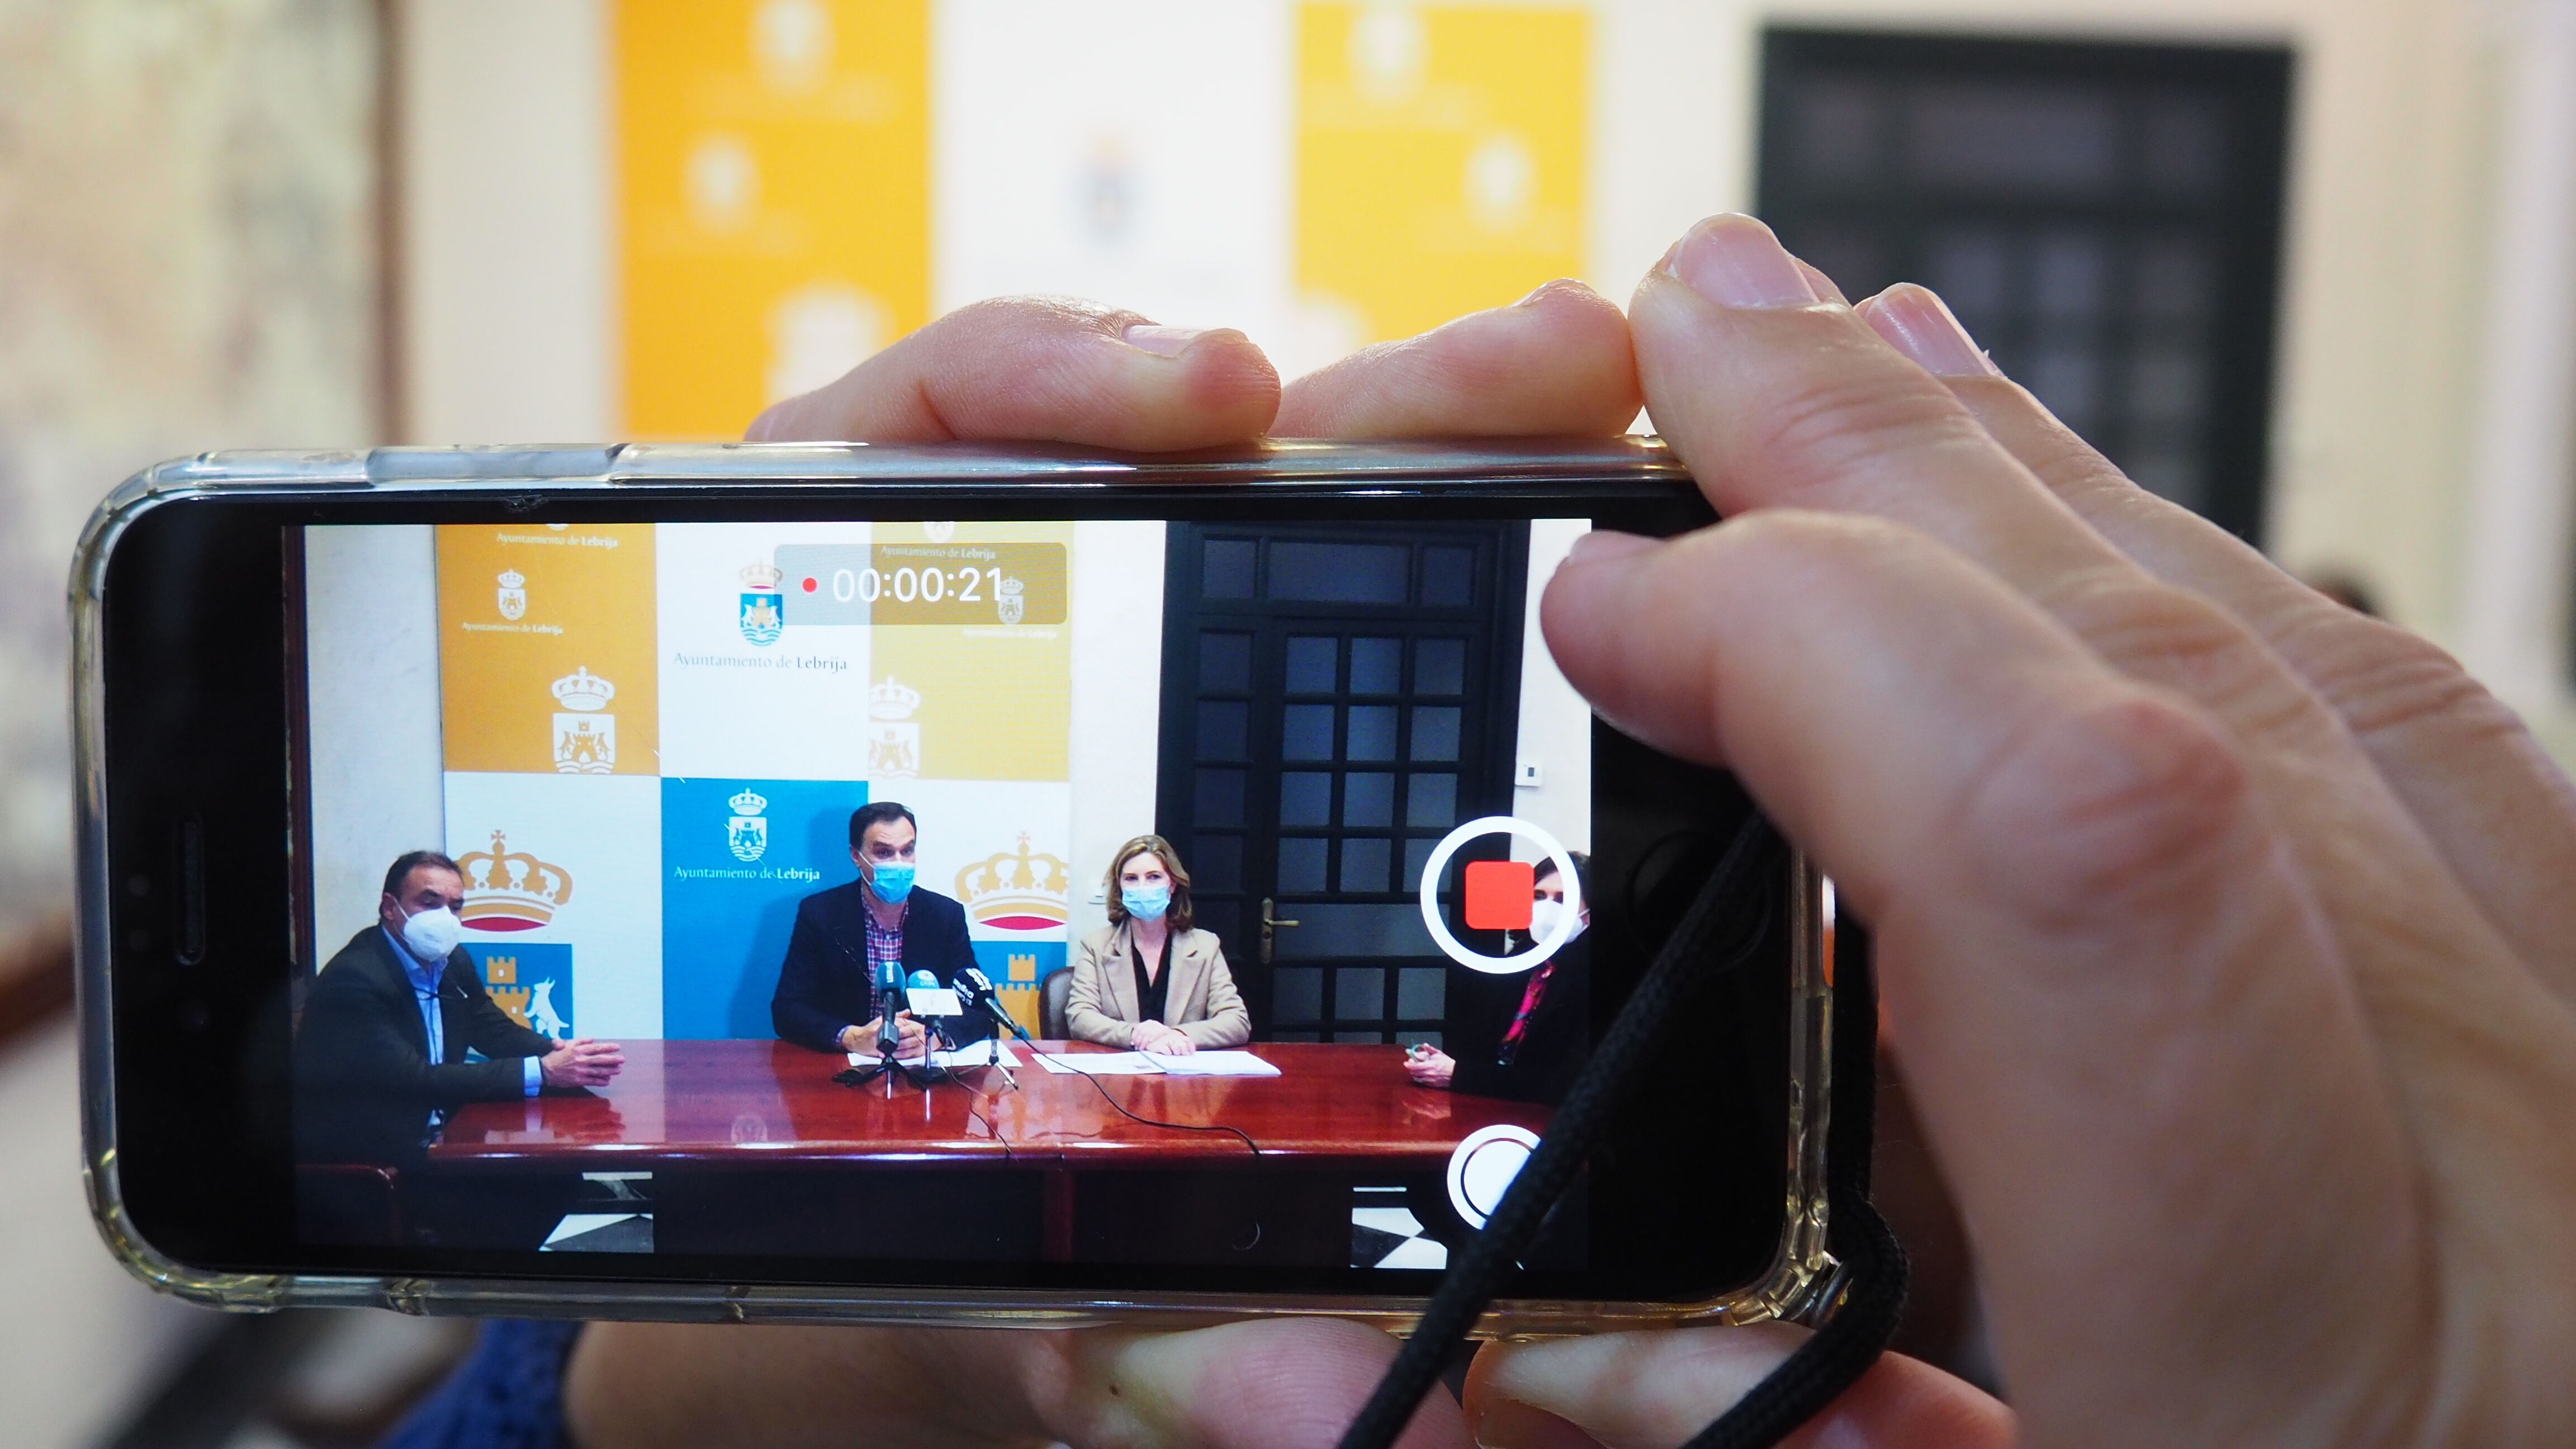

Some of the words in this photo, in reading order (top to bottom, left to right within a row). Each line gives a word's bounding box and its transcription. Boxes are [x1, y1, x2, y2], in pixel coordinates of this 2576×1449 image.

[496, 533, 566, 546] Ayuntamiento
[567, 535, 580, 546] de
[581, 536, 618, 550] Lebrija
[948, 547, 960, 558] de
[961, 548, 996, 562] Lebrija
[833, 567, 1001, 602] 00:00:21
[674, 652, 771, 669] Ayuntamiento
[776, 655, 792, 669] de
[797, 656, 847, 674] Lebrija
[674, 866, 756, 882] Ayuntamiento
[760, 867, 773, 879] de
[777, 866, 821, 883] Lebrija
